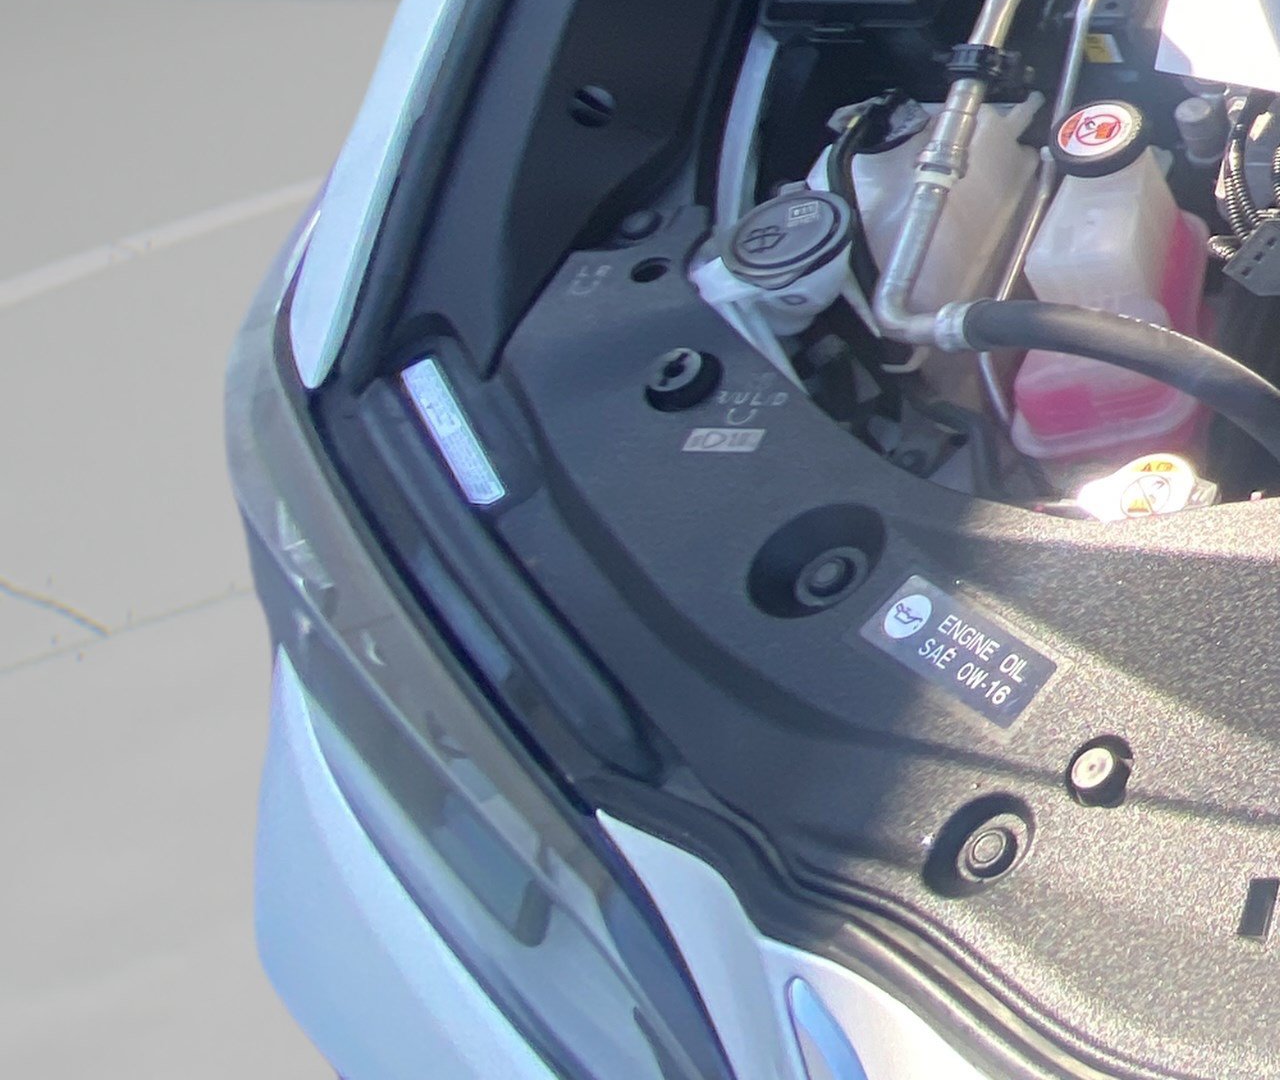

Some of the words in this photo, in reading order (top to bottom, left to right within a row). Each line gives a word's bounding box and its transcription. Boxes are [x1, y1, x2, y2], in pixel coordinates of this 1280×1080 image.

[918, 638, 957, 670] SAE
[956, 662, 1012, 705] 0W-16
[937, 614, 1000, 662] ENGINE
[999, 653, 1029, 684] OIL
